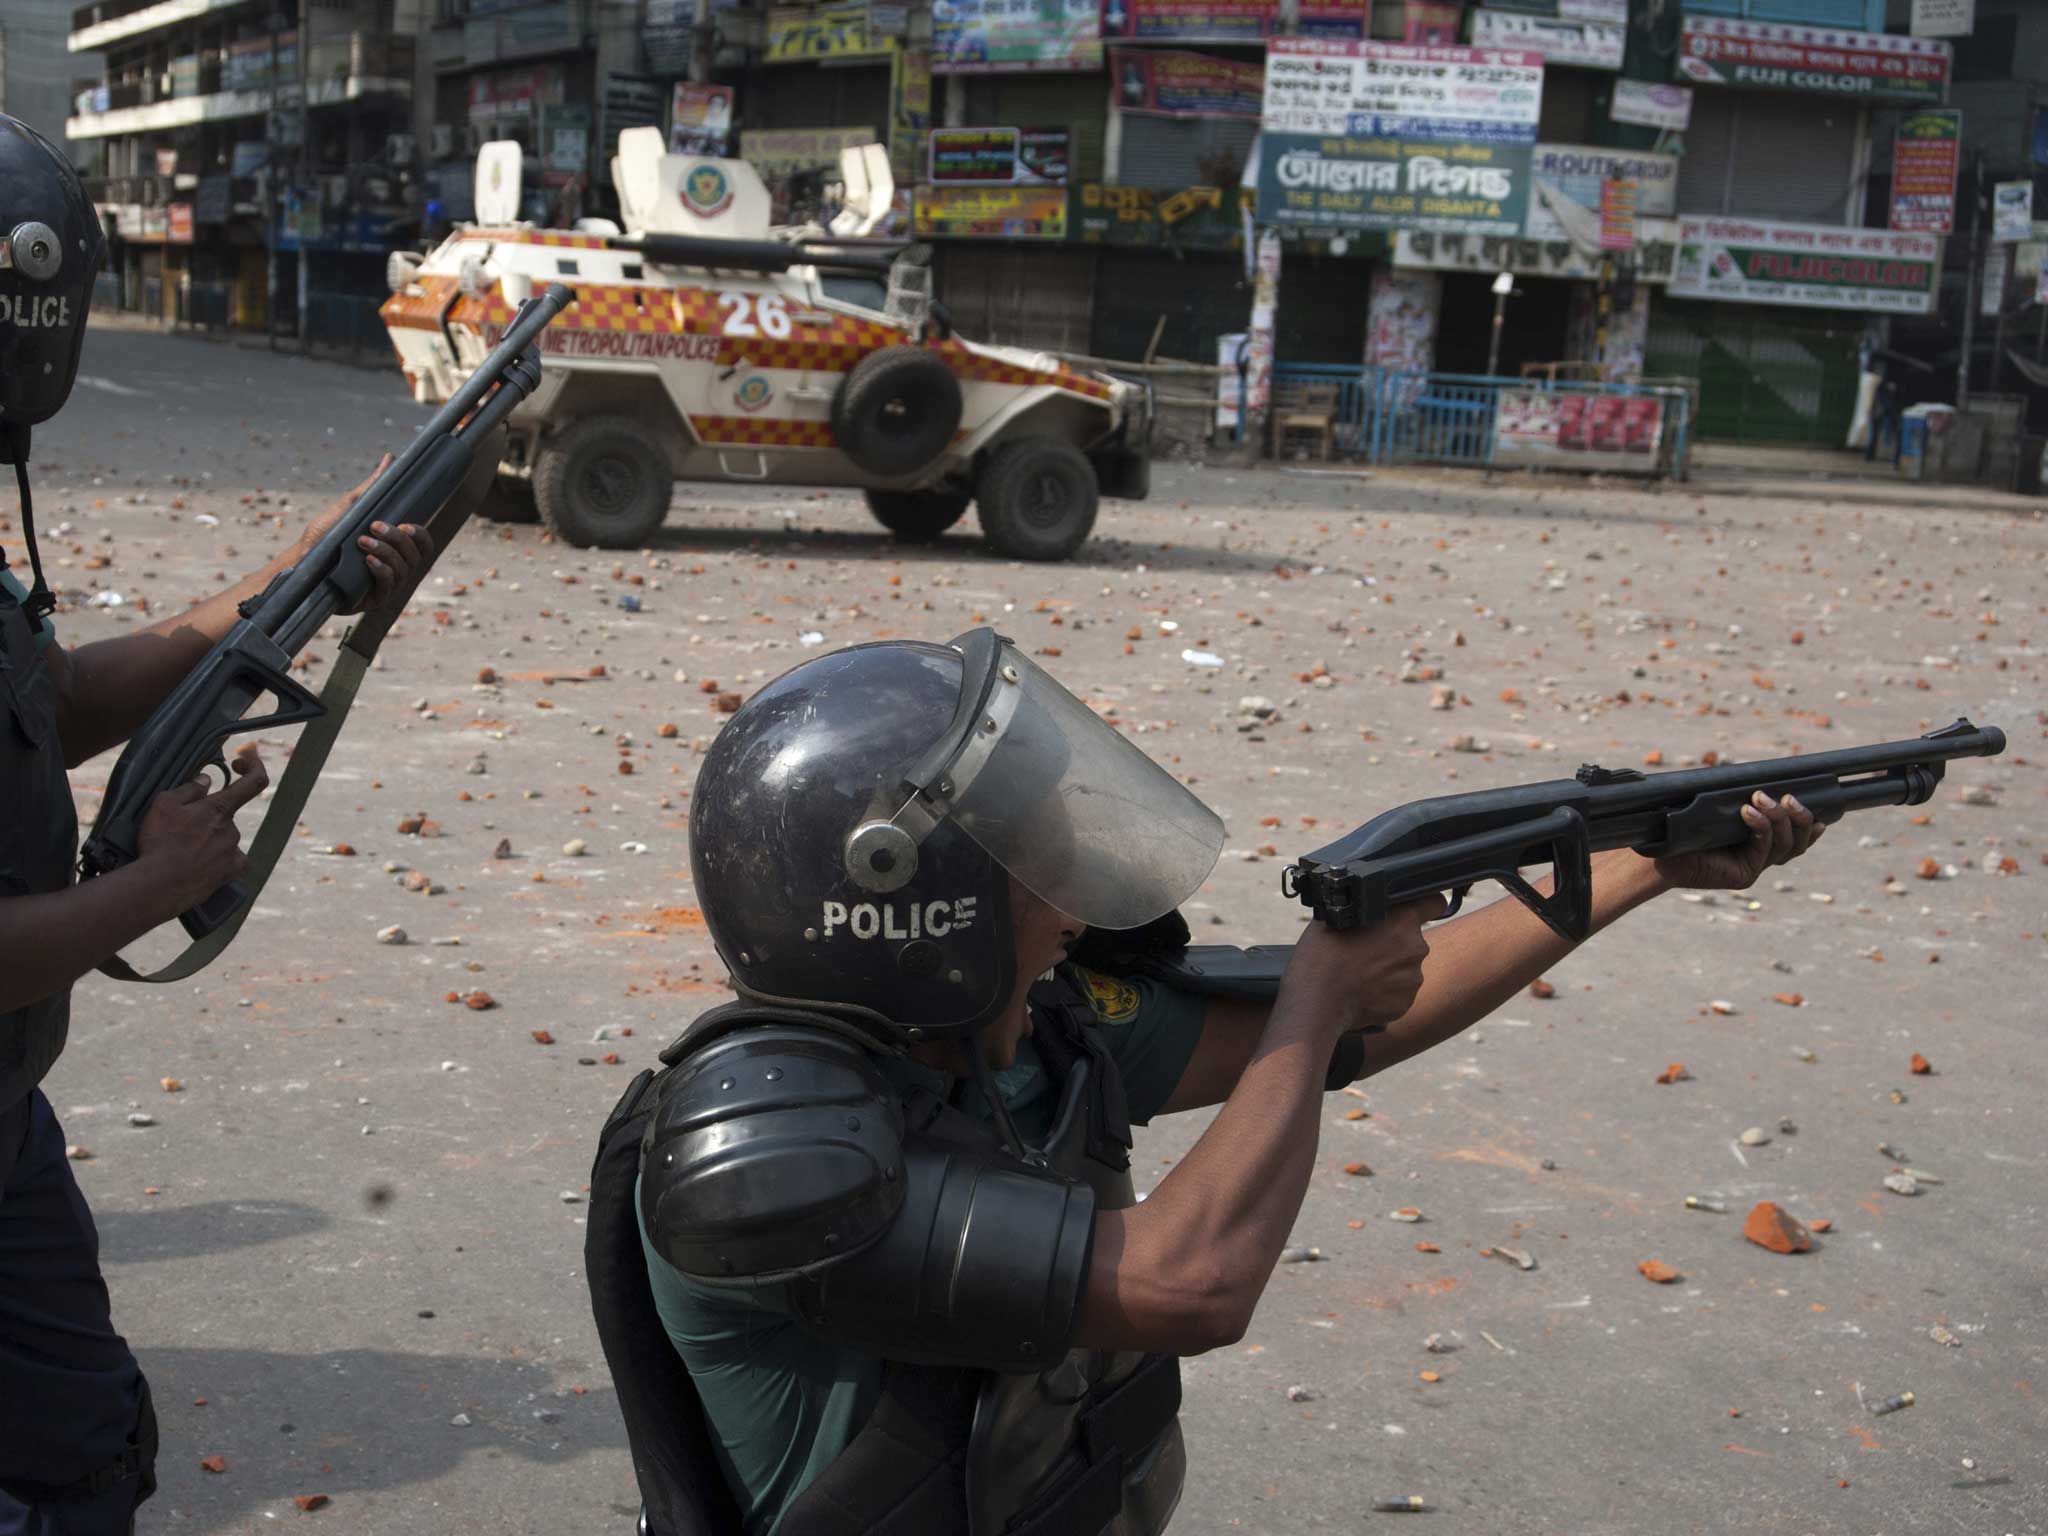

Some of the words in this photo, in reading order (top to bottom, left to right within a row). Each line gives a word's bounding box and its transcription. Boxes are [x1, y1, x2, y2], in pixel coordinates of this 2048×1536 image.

[1734, 65, 1788, 84] FUJI
[1790, 69, 1873, 91] COLOR
[1286, 191, 1313, 206] THE
[1320, 192, 1364, 209] DAILY
[1749, 253, 1927, 286] FUJICOLOR
[717, 291, 792, 339] 26
[823, 896, 977, 939] POLICE
